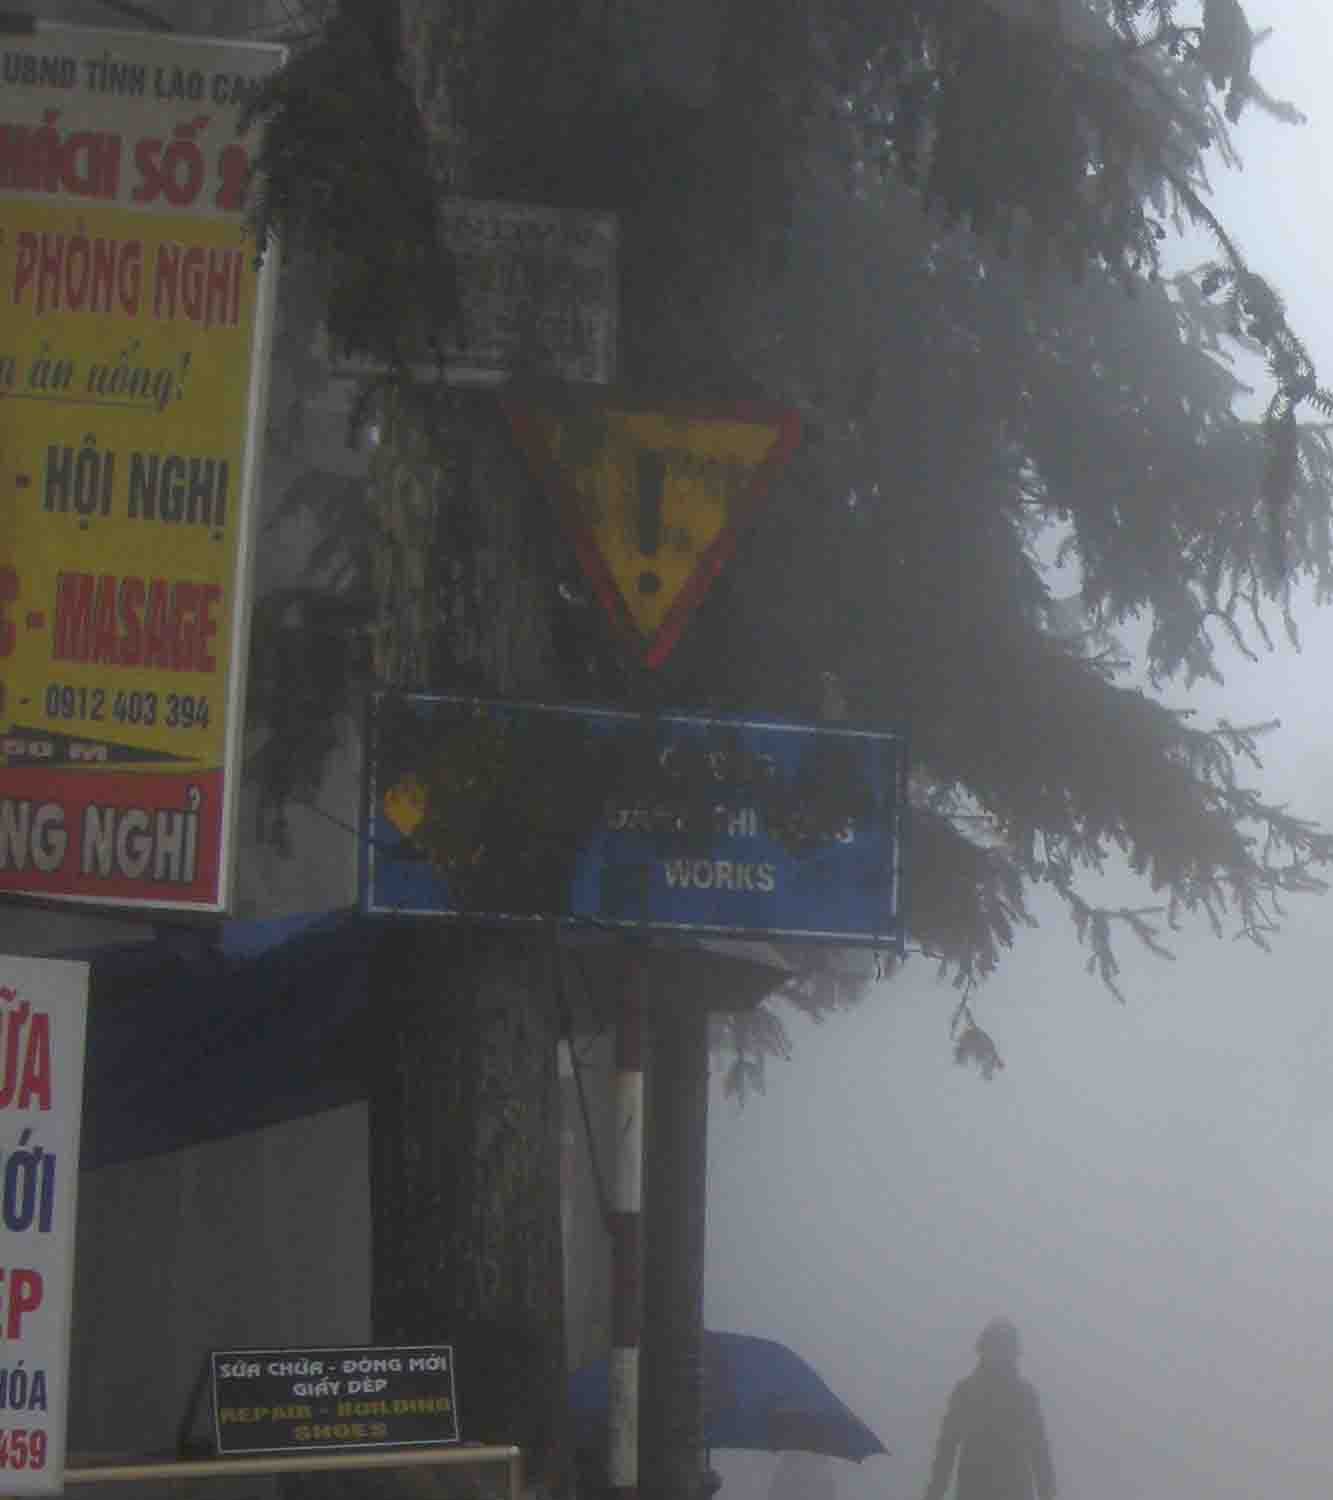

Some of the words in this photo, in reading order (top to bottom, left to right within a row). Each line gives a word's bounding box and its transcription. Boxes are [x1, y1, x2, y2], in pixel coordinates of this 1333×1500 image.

[45, 434, 114, 530] HỘI
[128, 452, 229, 541] NGHỊ
[46, 682, 106, 722] 0912
[80, 783, 201, 882] NGHỈ
[664, 859, 776, 893] WORKS
